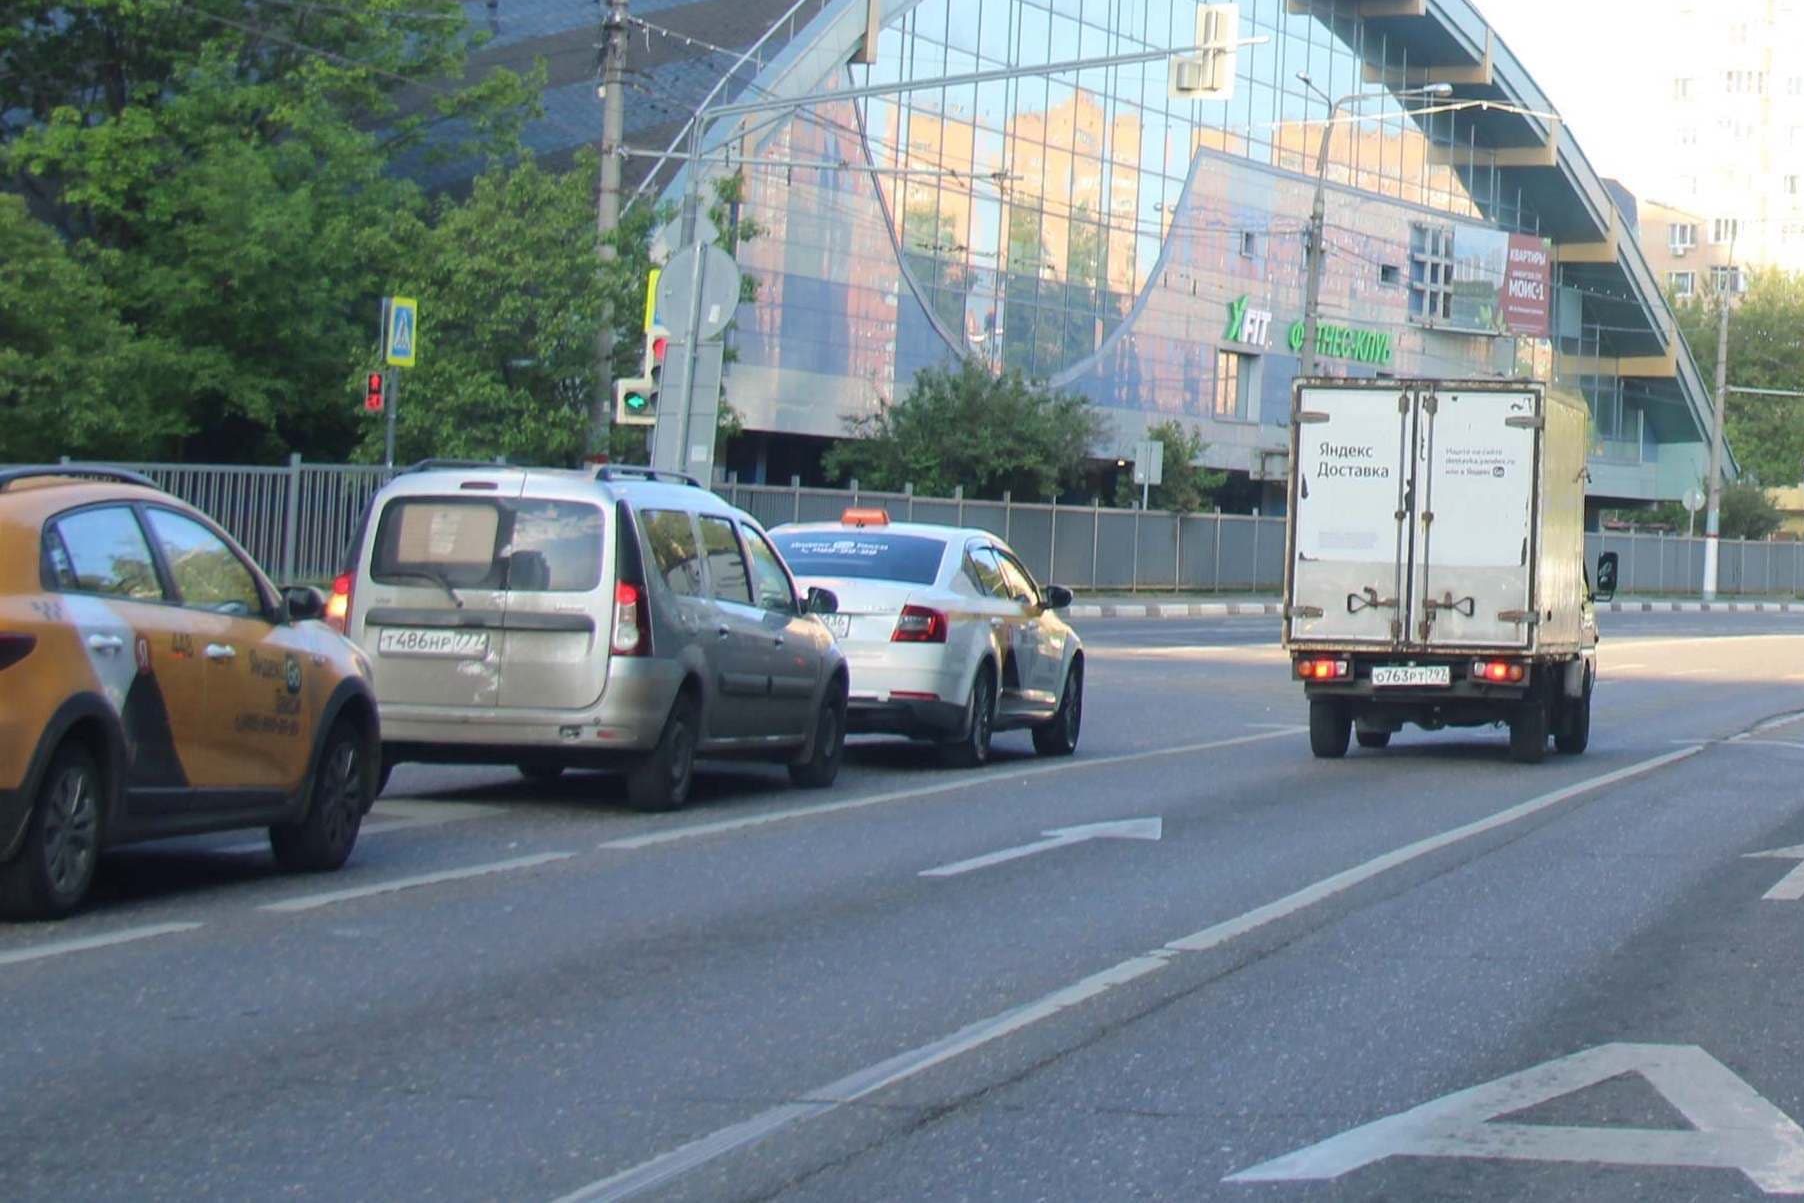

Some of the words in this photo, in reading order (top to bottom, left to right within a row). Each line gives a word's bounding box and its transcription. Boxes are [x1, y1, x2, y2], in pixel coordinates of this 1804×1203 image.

[1289, 320, 1392, 365] ФТНЕС-КЛУБ
[1319, 442, 1373, 458] Яндекс
[1317, 461, 1389, 478] Доставка
